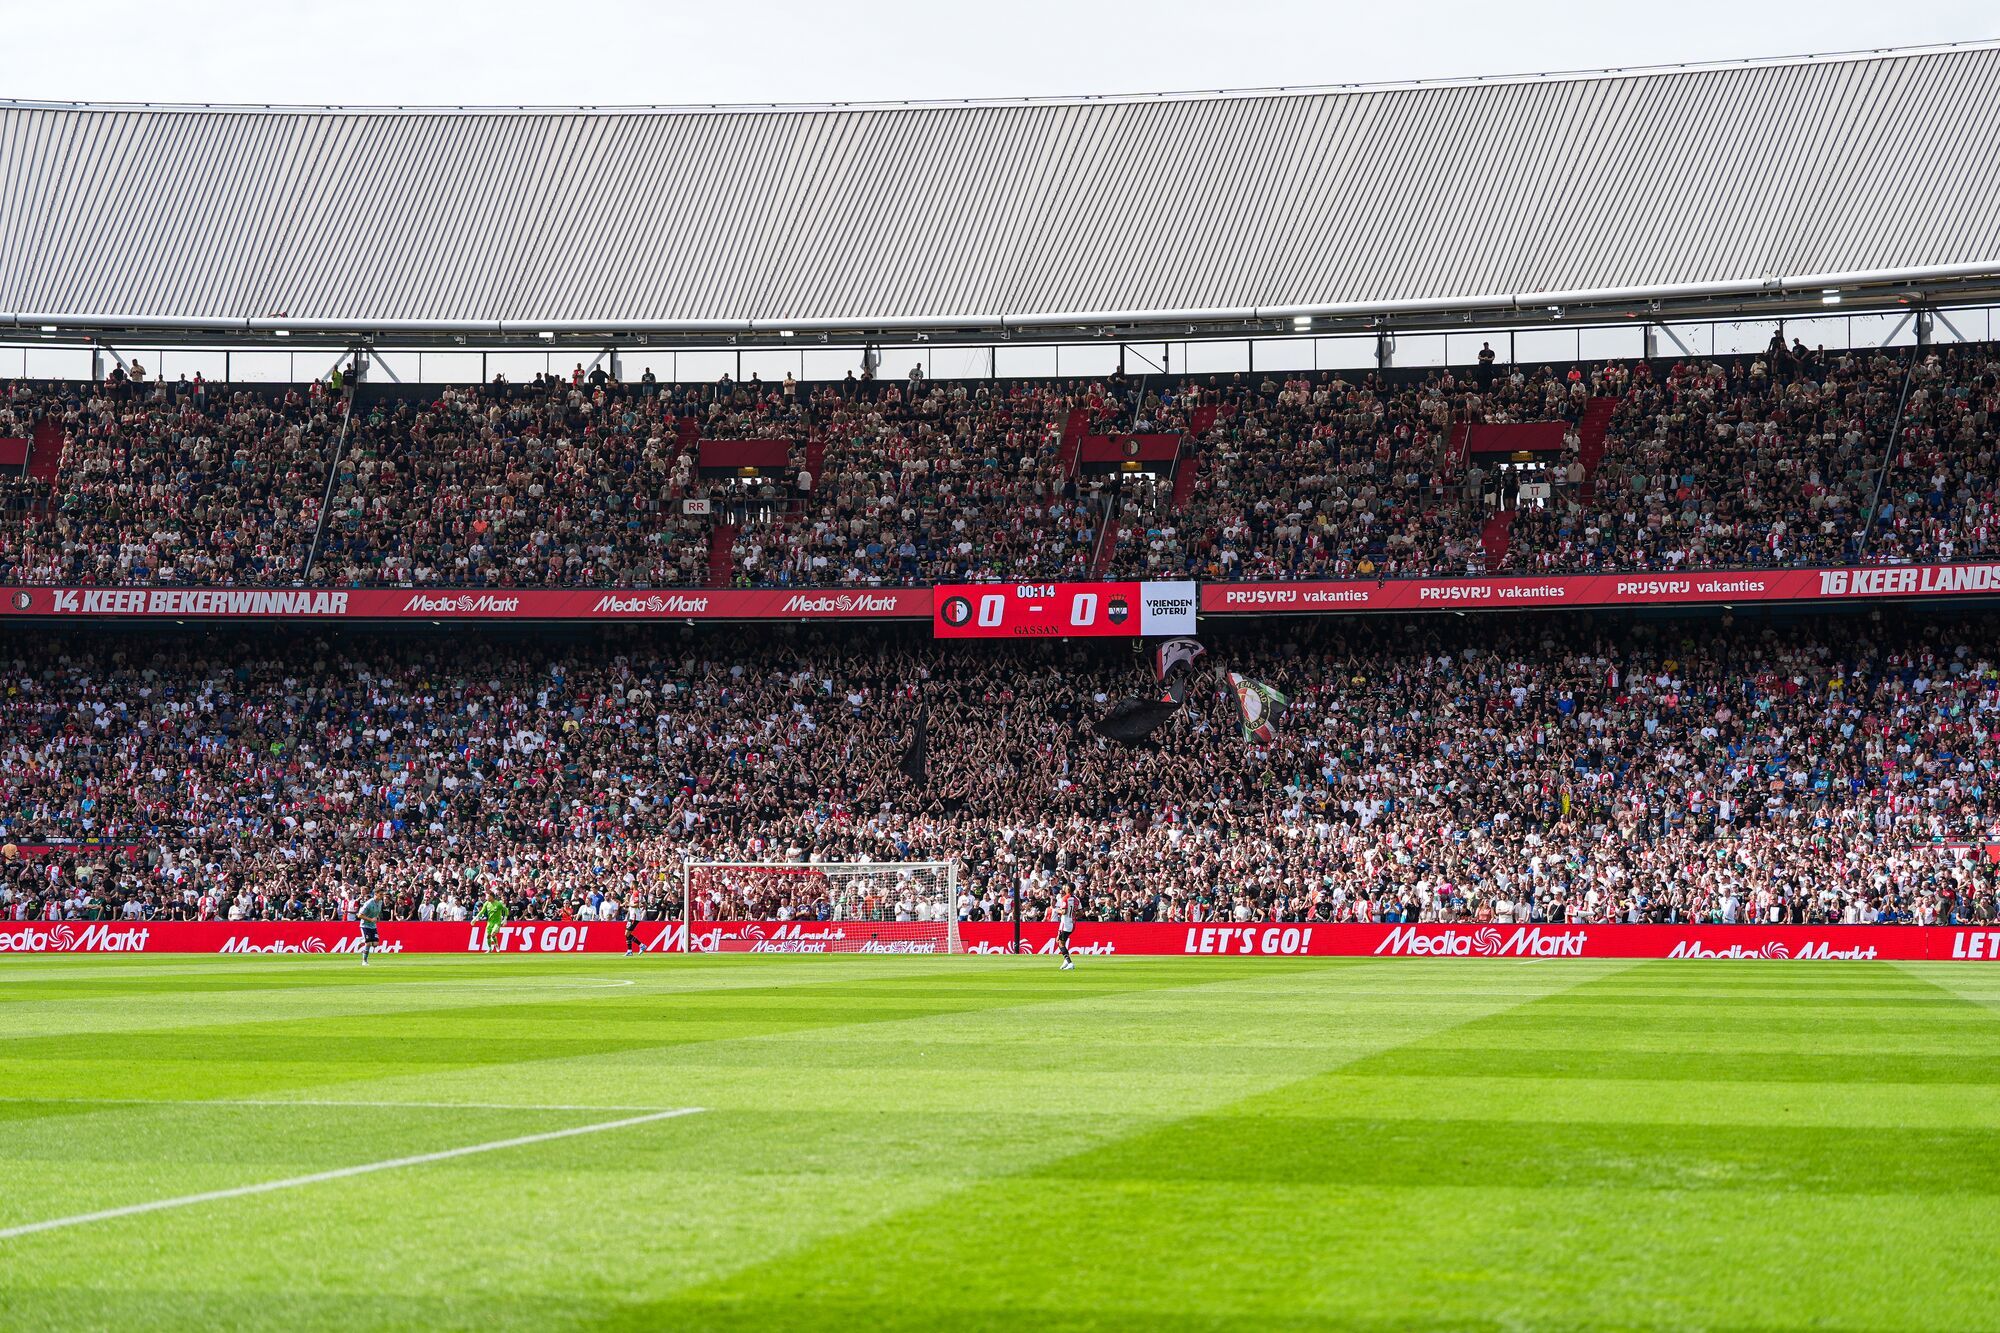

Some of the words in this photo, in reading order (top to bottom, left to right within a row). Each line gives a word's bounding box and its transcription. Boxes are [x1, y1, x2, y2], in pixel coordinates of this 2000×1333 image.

[688, 502, 704, 511] RR
[1697, 579, 1765, 593] vakanties
[1820, 571, 1848, 594] 16
[1850, 569, 1918, 593] KEER
[1016, 585, 1056, 598] 00:14
[1303, 589, 1369, 602] vakanties
[1497, 584, 1565, 598] vakanties
[53, 590, 78, 612] 14
[82, 591, 146, 613] KEER
[147, 590, 348, 614] BEKERWINNAAR
[1146, 599, 1193, 608] VRIENDEN
[978, 595, 1006, 627] 0
[1070, 593, 1098, 626] 0
[1152, 607, 1187, 616] LOTERIJ
[1014, 626, 1059, 635] GASSAN
[0, 928, 48, 951] edia
[541, 927, 588, 951] GO!
[1184, 928, 1256, 953] LET'S
[1261, 928, 1312, 954] GO!
